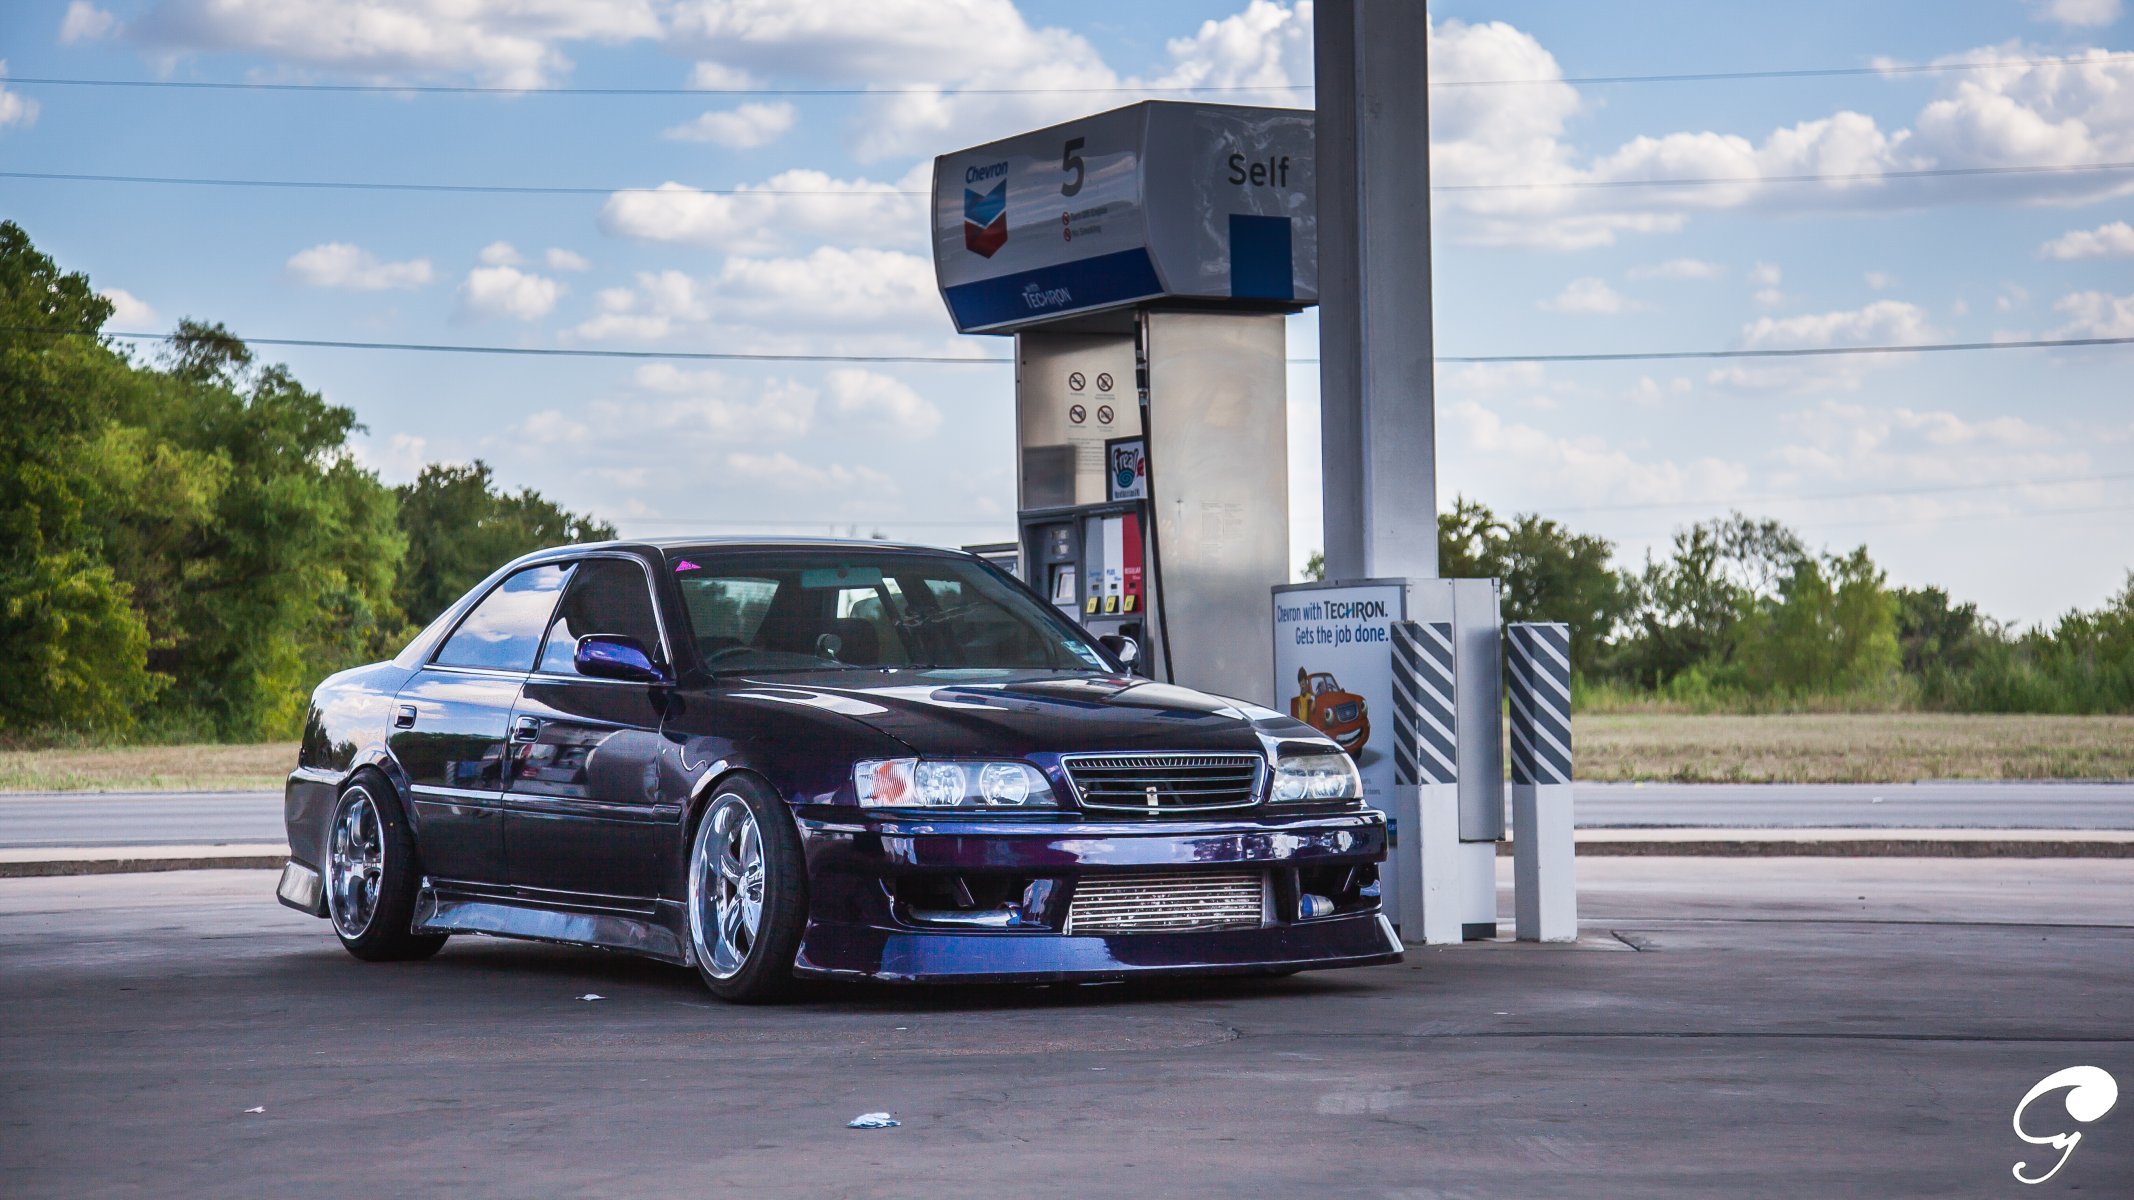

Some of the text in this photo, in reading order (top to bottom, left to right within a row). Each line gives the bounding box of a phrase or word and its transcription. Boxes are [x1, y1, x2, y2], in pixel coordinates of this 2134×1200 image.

[965, 161, 1009, 184] Chevron
[1061, 136, 1085, 197] 5
[1228, 153, 1290, 188] Self
[1021, 287, 1073, 309] TECHRON
[1277, 600, 1389, 623] Chevron with TECHRON.
[1296, 624, 1389, 648] Gets the job done.
